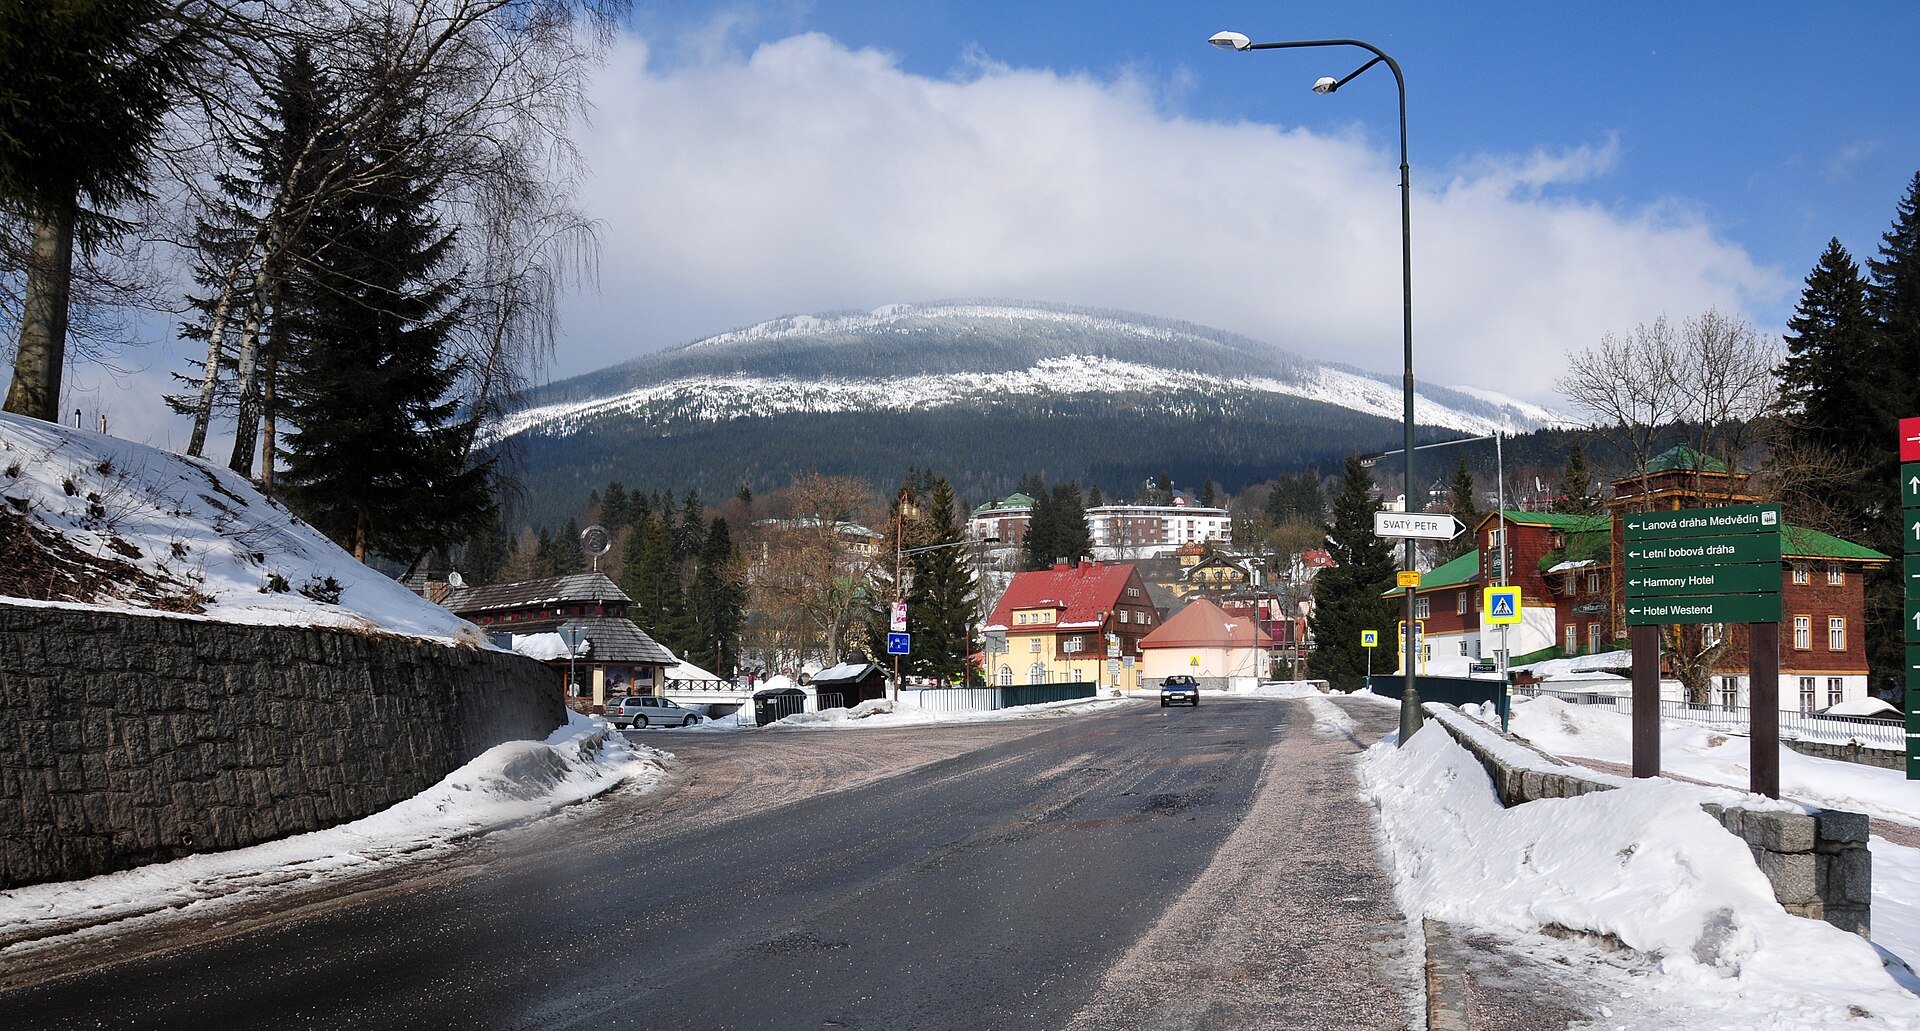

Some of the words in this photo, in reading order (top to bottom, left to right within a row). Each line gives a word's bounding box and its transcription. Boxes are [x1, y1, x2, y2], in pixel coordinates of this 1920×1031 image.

[1383, 519, 1411, 530] SVATÝ
[1414, 521, 1438, 531] PETR
[1642, 518, 1677, 531] Lanová
[1679, 516, 1708, 528] dráha
[1709, 513, 1759, 526] Medvědín
[1642, 548, 1667, 559] Letní
[1668, 546, 1704, 558] bobová
[1706, 544, 1735, 555] dráha
[1643, 577, 1687, 589] Harmony
[1688, 574, 1715, 586] Hotel
[1643, 605, 1668, 616] Hotel
[1669, 604, 1713, 616] Westend
